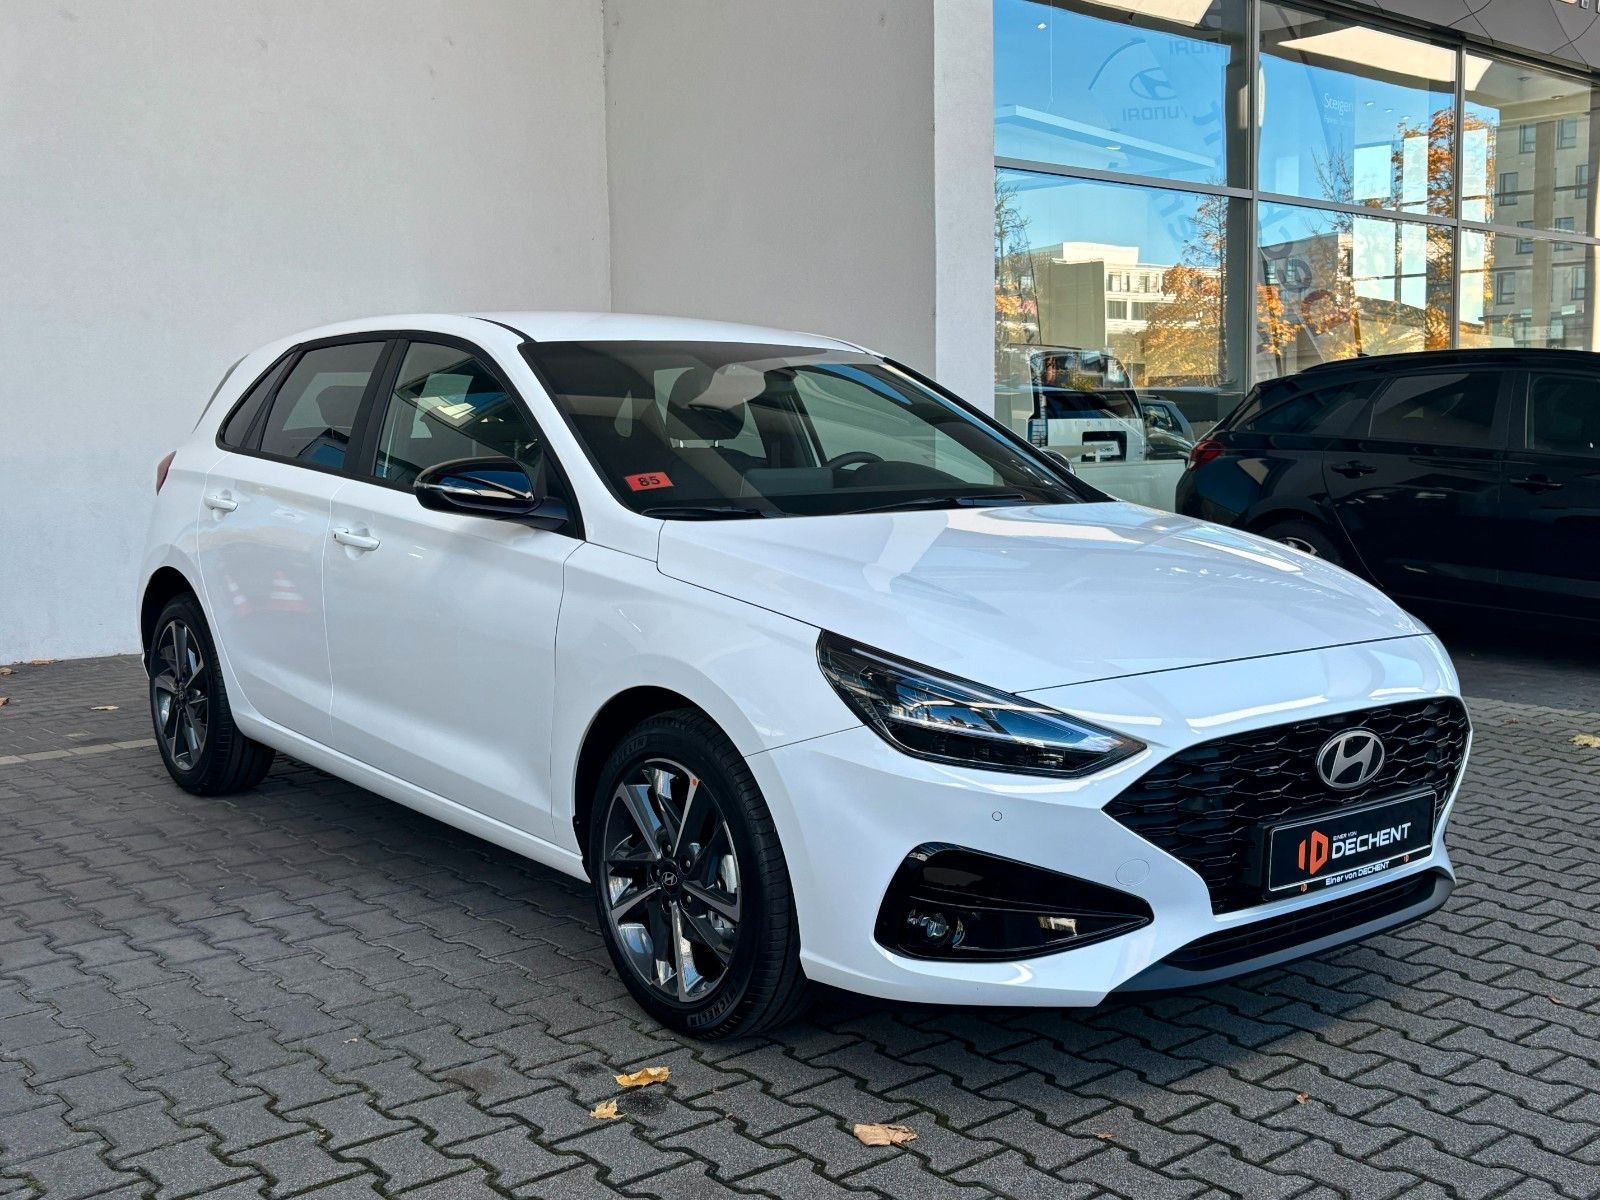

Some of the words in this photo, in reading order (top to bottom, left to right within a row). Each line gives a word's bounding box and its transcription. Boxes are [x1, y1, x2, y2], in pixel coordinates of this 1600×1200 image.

[638, 475, 661, 486] 85
[1332, 822, 1411, 859] DECHENT
[1325, 874, 1344, 885] Einer
[1344, 871, 1358, 880] von
[1358, 861, 1390, 876] DECHENT
